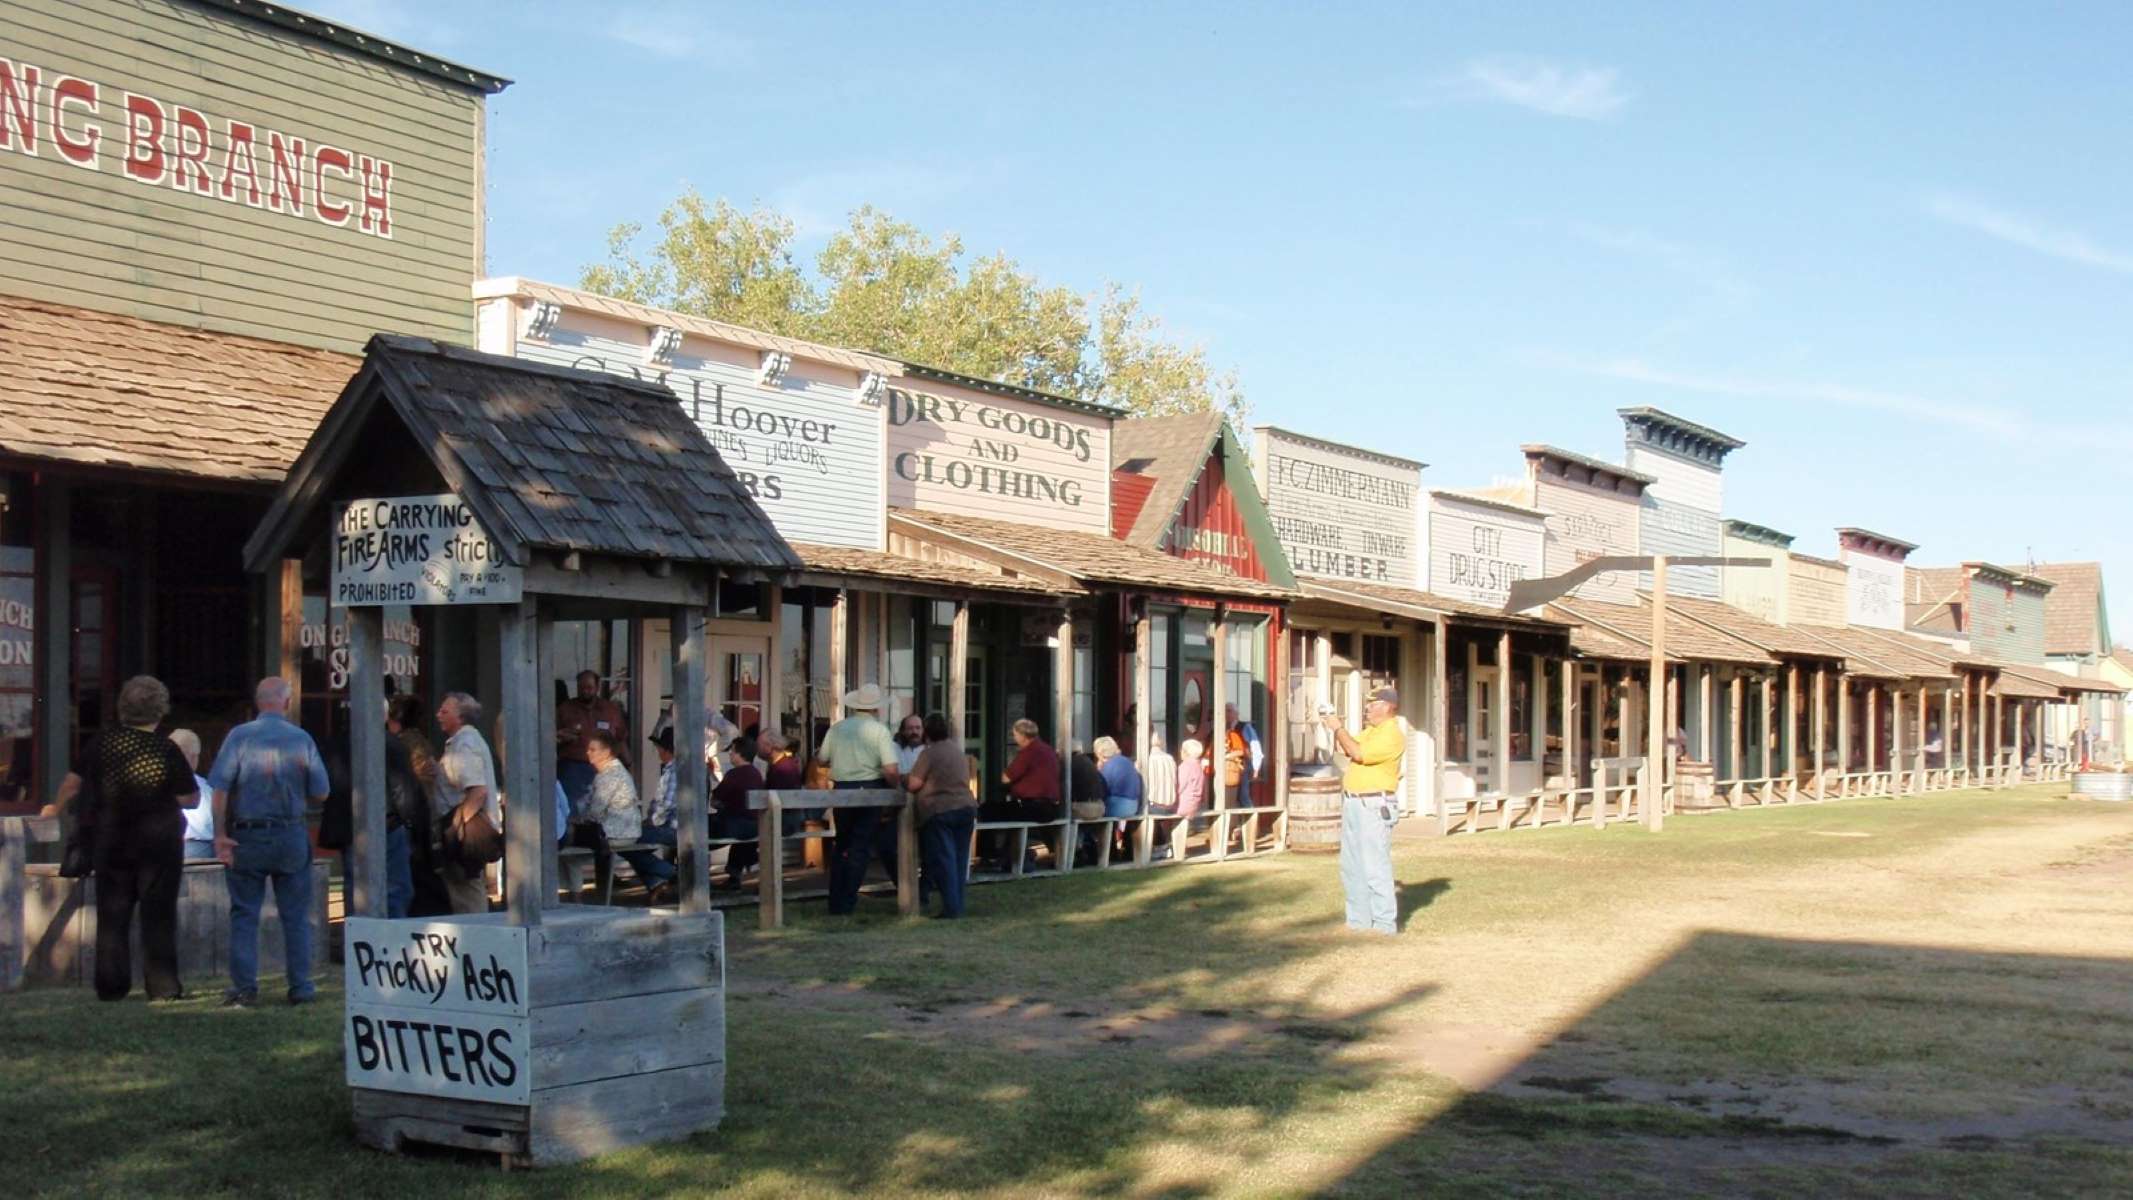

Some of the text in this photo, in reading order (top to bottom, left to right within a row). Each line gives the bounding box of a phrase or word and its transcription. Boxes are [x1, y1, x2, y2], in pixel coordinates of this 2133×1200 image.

[123, 92, 393, 239] BRANCH
[690, 378, 836, 444] Hoover
[887, 387, 1090, 462] DRY GOODS
[765, 440, 828, 475] LIQUORS
[968, 438, 1019, 462] AND
[894, 452, 1082, 506] CLOTHING
[337, 501, 472, 532] THE CARRYING
[1472, 526, 1502, 558] CITY
[1292, 546, 1389, 581] LUMBER
[0, 599, 34, 629] CH
[410, 931, 458, 960] TRY
[353, 941, 520, 1006] Prickly Ash
[351, 1014, 518, 1088] BITTERS
